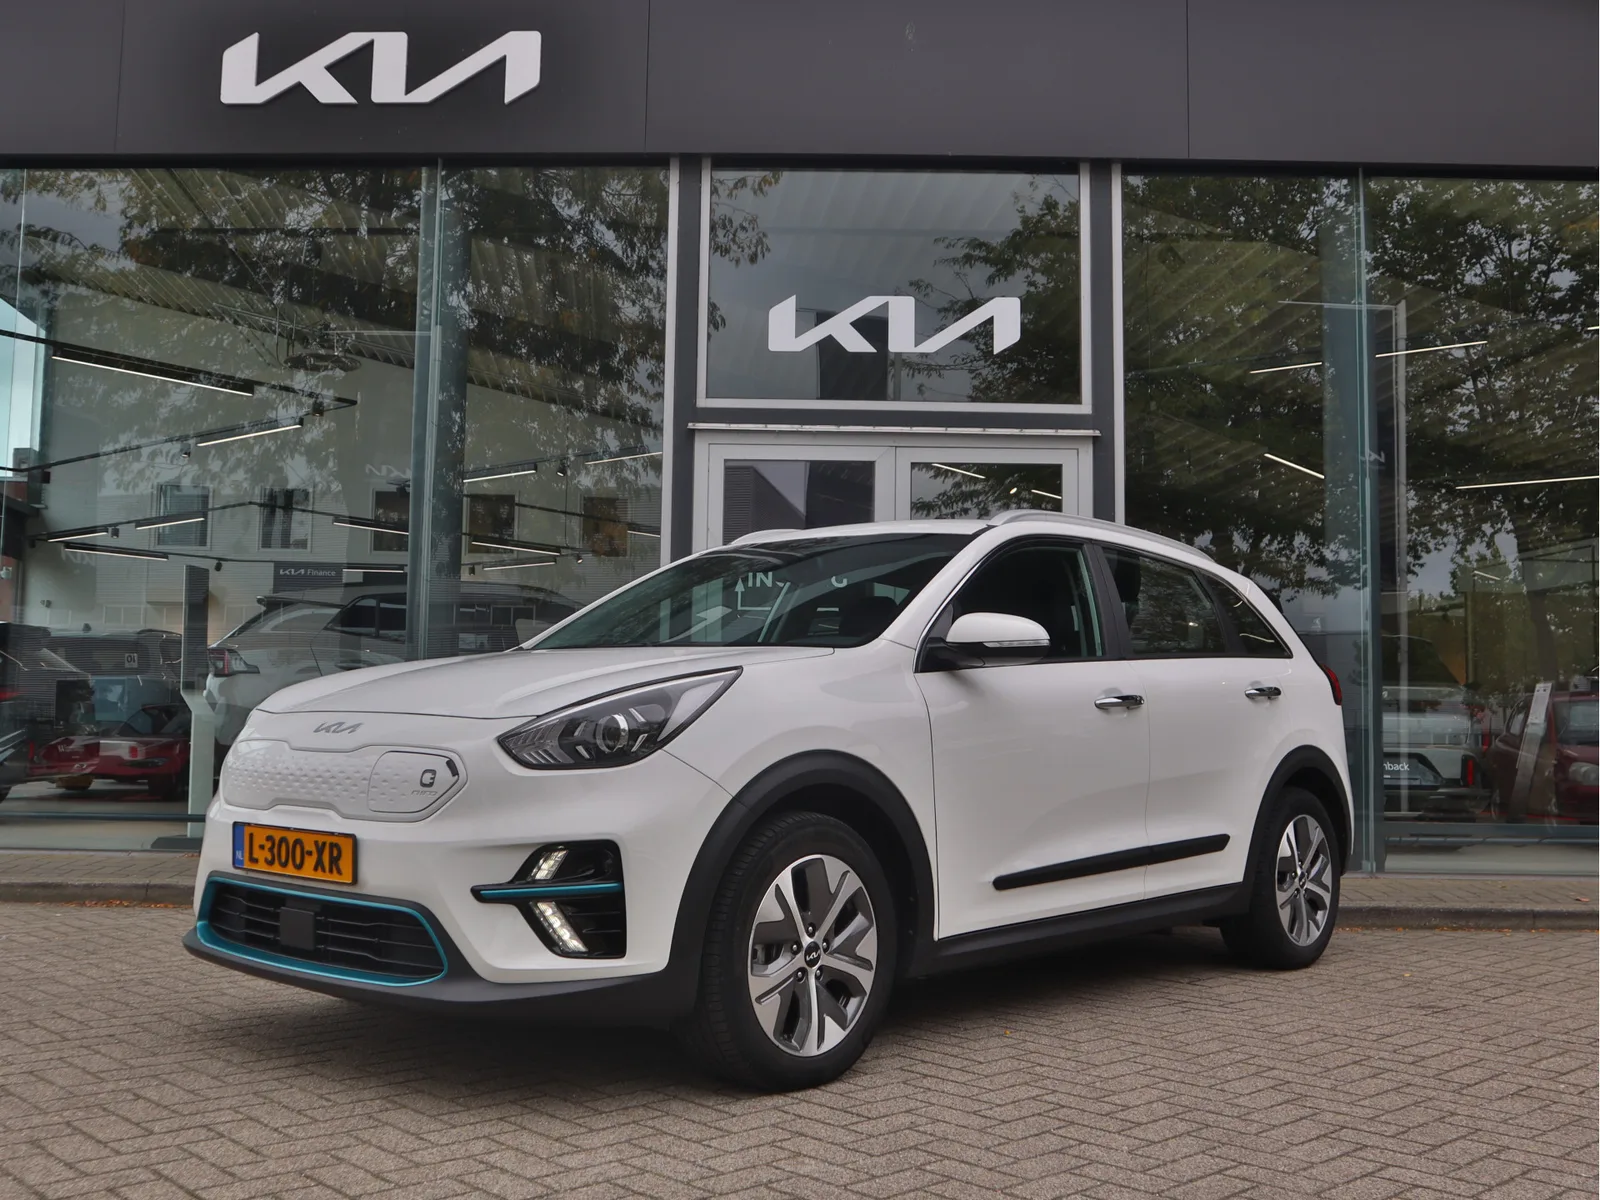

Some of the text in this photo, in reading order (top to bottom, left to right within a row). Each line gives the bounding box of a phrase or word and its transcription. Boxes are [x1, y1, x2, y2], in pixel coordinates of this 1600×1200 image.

[220, 30, 542, 105] KIA
[768, 294, 1021, 355] KIA
[280, 568, 305, 576] KIA
[313, 721, 364, 734] KIA
[236, 850, 243, 860] NL
[248, 832, 343, 876] L-300-XR
